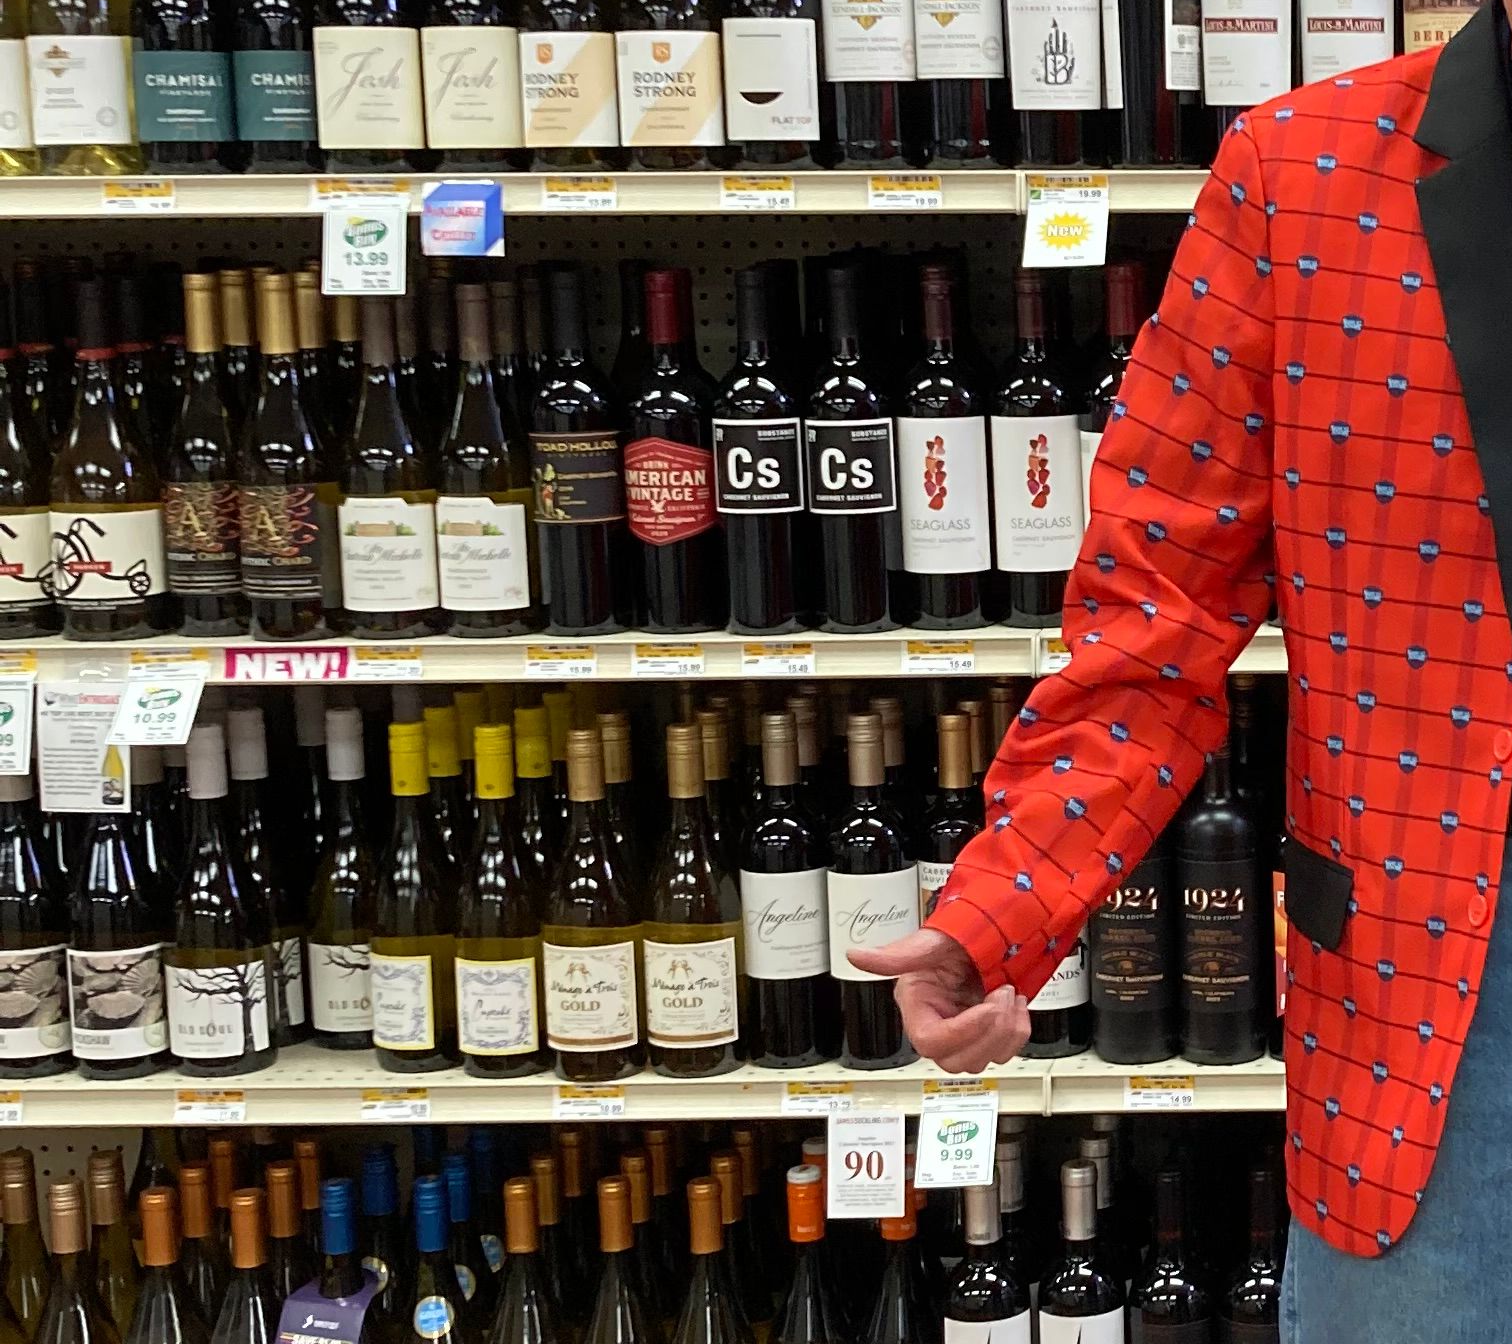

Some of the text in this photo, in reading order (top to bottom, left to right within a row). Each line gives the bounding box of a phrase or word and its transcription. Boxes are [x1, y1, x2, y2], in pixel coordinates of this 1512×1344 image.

[1235, 19, 1274, 32] MARTINI
[1345, 18, 1383, 32] MARTINI
[632, 71, 696, 84] RODNEY
[632, 85, 697, 98] STRONG
[772, 115, 795, 125] FLAT
[1078, 190, 1102, 198] 19.99
[343, 251, 389, 267] 13.99
[536, 441, 568, 453] TOAD
[727, 446, 781, 490] Cs
[820, 447, 874, 490] Cs
[627, 487, 695, 502] VINTAGE
[911, 517, 970, 531] SEAGLASS
[1011, 515, 1072, 530] SEAGLASS
[235, 651, 342, 680] NEW!
[949, 660, 972, 669] 15.49
[134, 712, 177, 725] 10.99
[1184, 887, 1244, 912] 1924
[749, 899, 821, 943] Angeline
[838, 899, 911, 944] Angeline
[560, 998, 600, 1011] GOLD
[662, 996, 703, 1009] GOLD
[1170, 1095, 1192, 1104] 14.99
[940, 1148, 973, 1162] 9.99
[845, 1150, 885, 1182] 90
